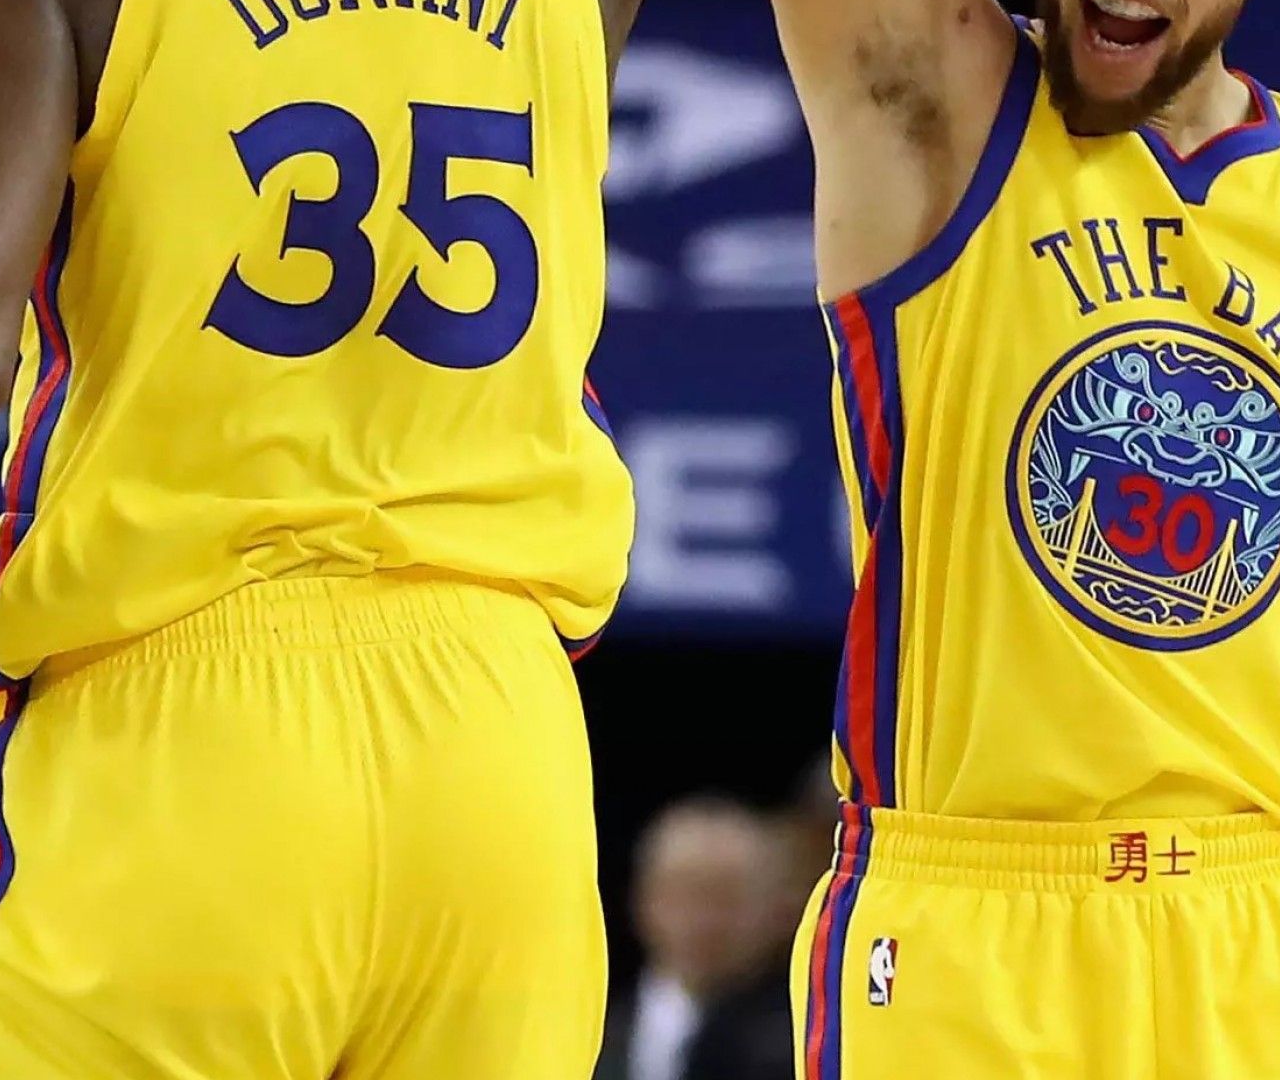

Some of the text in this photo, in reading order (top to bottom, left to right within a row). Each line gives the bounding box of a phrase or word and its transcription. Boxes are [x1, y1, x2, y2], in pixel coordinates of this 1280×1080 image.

[201, 101, 539, 368] 35
[1030, 217, 1188, 316] THE
[1108, 475, 1216, 573] 30
[1104, 831, 1196, 883] 勇士
